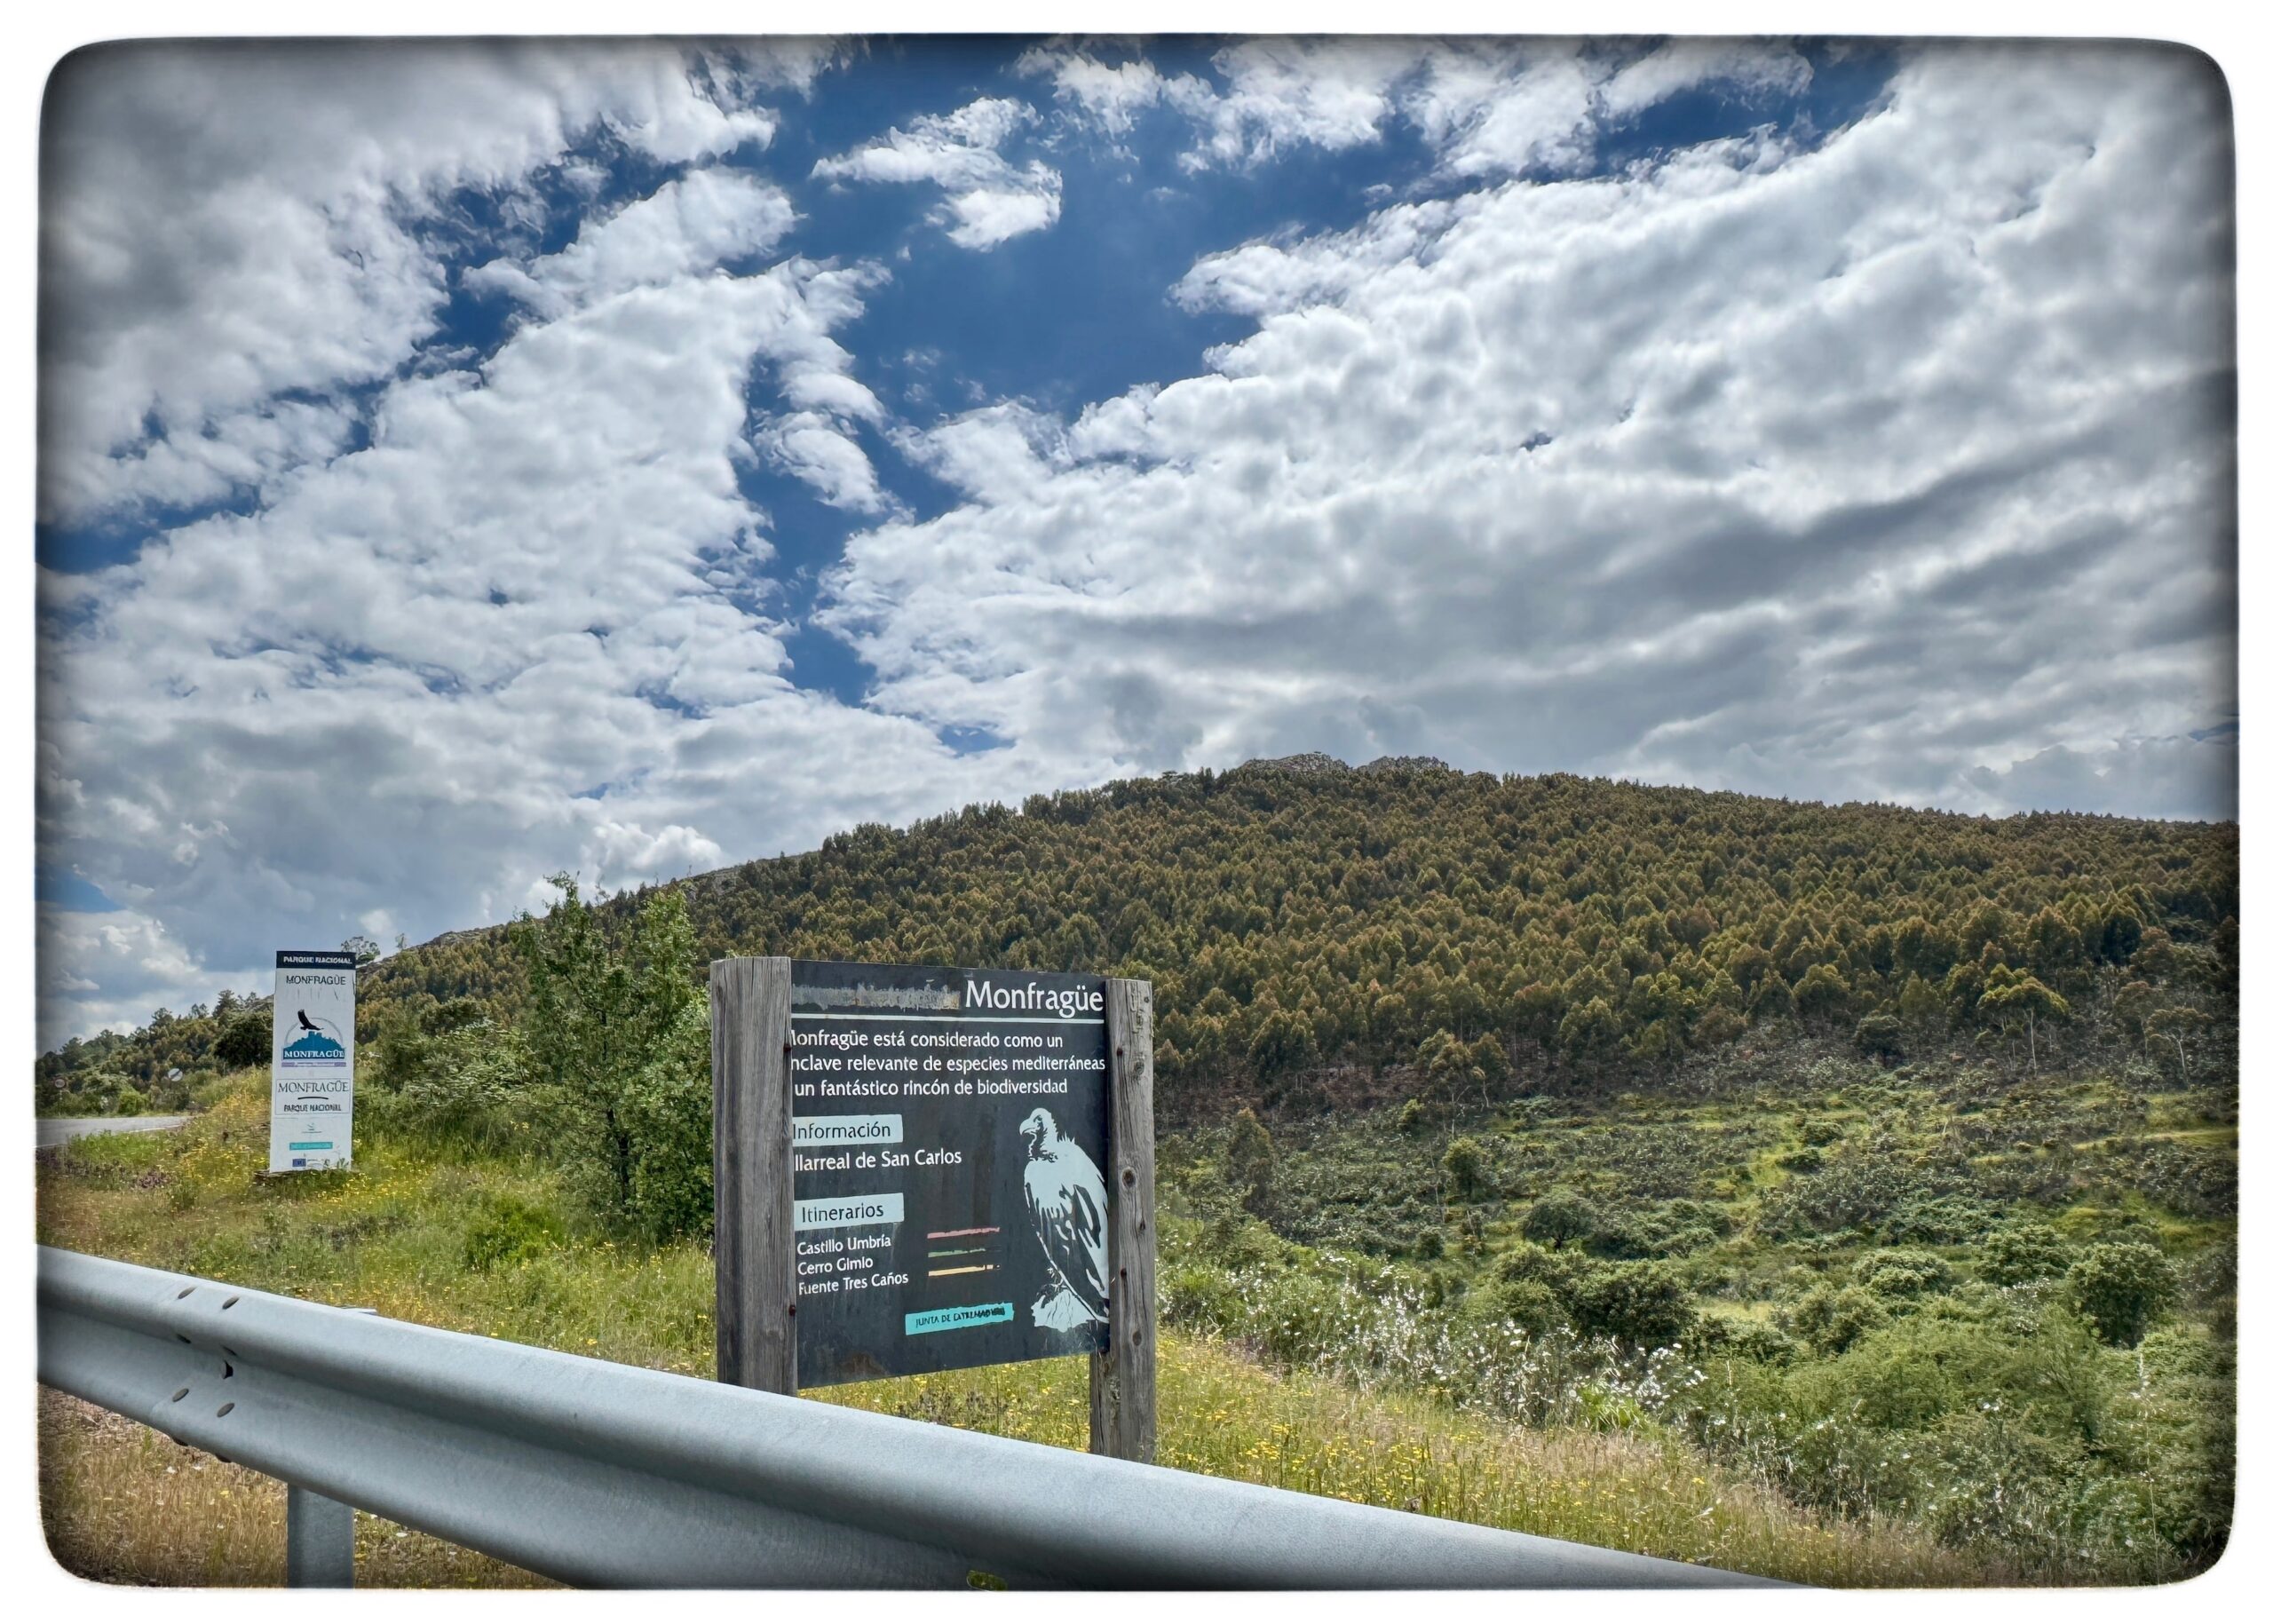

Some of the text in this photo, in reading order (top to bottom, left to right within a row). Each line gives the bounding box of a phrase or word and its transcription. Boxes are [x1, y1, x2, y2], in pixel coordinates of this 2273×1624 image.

[286, 974, 346, 985] MONFRAGÜE
[965, 979, 1104, 1018] Monfragüe
[874, 1030, 906, 1047] está
[910, 1031, 1000, 1048] considerado
[1004, 1035, 1042, 1048] como
[1047, 1035, 1063, 1048] un
[284, 1049, 345, 1058] MONFRAGÜE
[791, 1054, 1105, 1074] nclave relevante de especies mediterráneas
[278, 1080, 349, 1093] MONFRAGÜE
[795, 1078, 1068, 1097] un fantástico rincón de biodiversidad
[793, 1121, 891, 1140] Información
[795, 1147, 962, 1171] llarreal de San Carlos
[802, 1202, 884, 1223] Itinerarios
[796, 1233, 891, 1256] Castillo Umbría
[797, 1262, 833, 1276] Cerro
[799, 1271, 909, 1295] Fuente Tres Caños
[915, 1316, 939, 1328] JUNTA
[941, 1314, 951, 1323] DE
